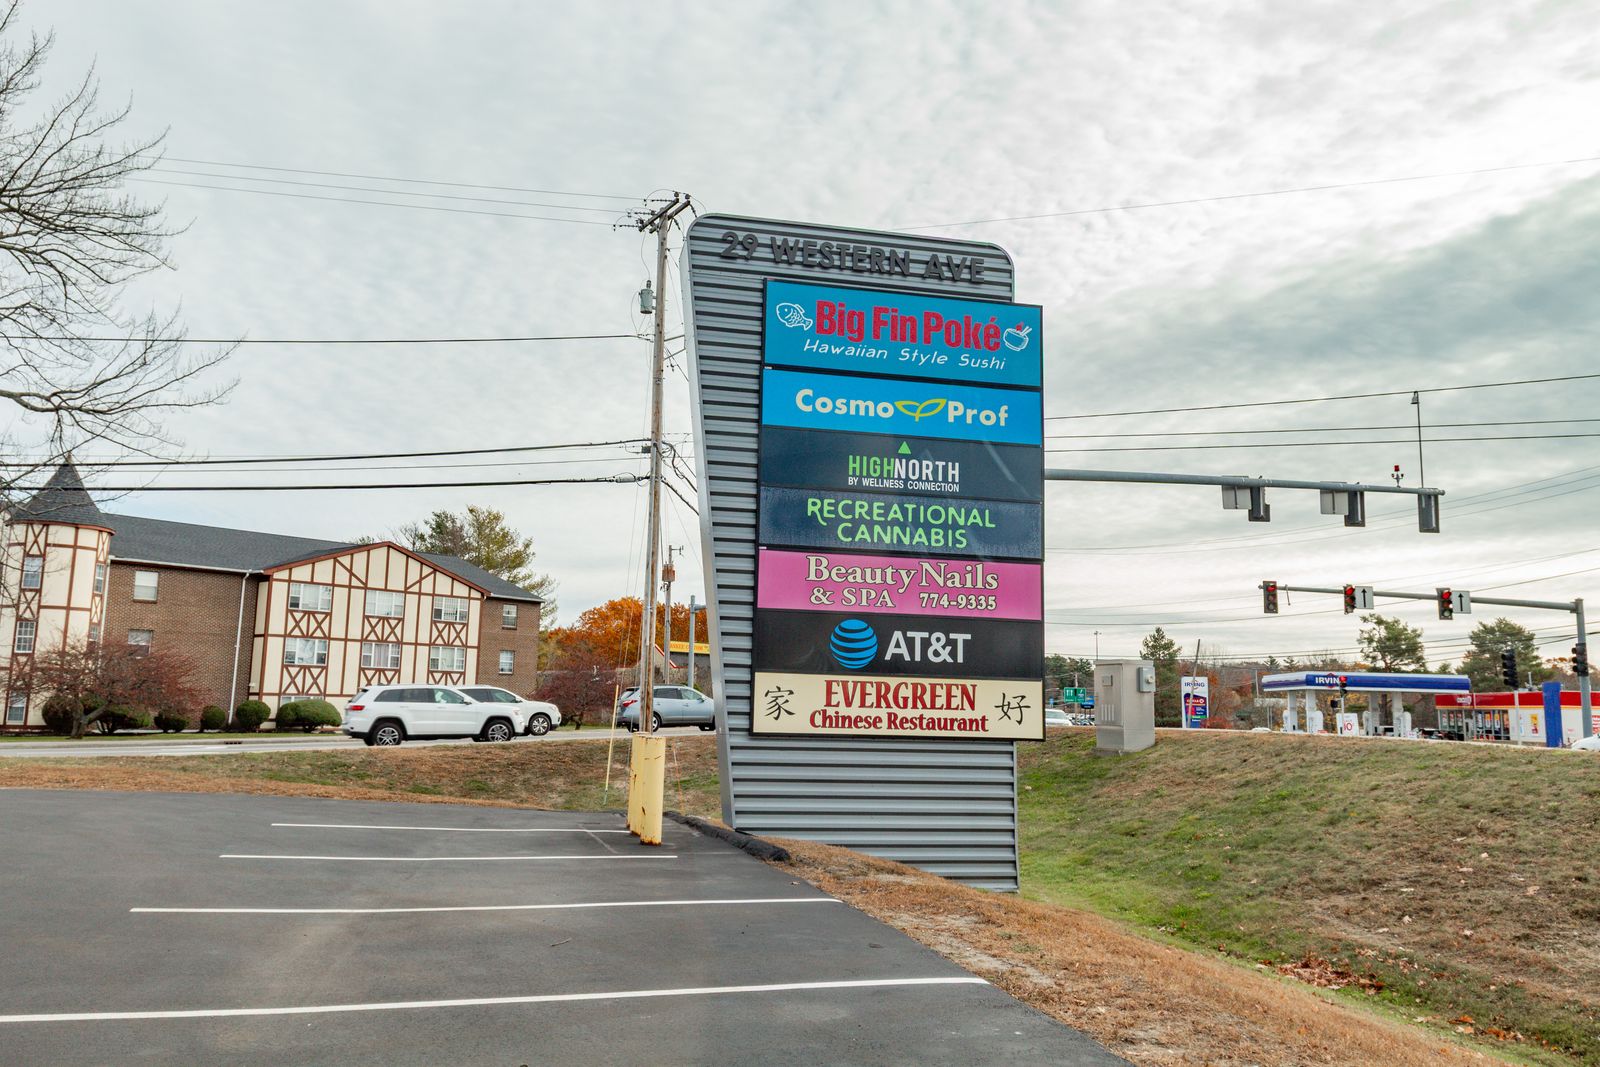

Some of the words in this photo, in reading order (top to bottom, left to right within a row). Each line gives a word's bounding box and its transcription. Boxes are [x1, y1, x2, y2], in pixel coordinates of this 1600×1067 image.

[720, 230, 759, 261] 29
[769, 235, 911, 277] WESTERN
[923, 253, 986, 284] AVE
[815, 299, 866, 343] Big
[872, 306, 919, 346] Fin
[923, 311, 1002, 352] Poké
[803, 339, 888, 360] Hawaiian
[898, 348, 949, 367] Style
[958, 353, 1007, 371] Sushi
[795, 388, 895, 420] Cosmo
[947, 401, 1009, 427] Prof
[848, 476, 859, 486] BY
[862, 477, 904, 490] WELLNESS
[907, 480, 960, 493] CONNECTION
[807, 497, 996, 529] RECREATIONAL
[837, 522, 968, 549] CANNABIS
[805, 554, 918, 594] Beauty
[919, 561, 999, 590] Nails
[809, 586, 835, 606] &
[841, 587, 896, 608] SPA
[919, 592, 997, 611] 774-9335
[884, 629, 972, 664] AT&T
[823, 678, 978, 712] EVERGREEN
[1315, 676, 1341, 685] IRVIN
[764, 685, 796, 721] 家
[994, 692, 1031, 726] 好
[809, 709, 883, 731] Chinese
[886, 711, 990, 732] Restaurant
